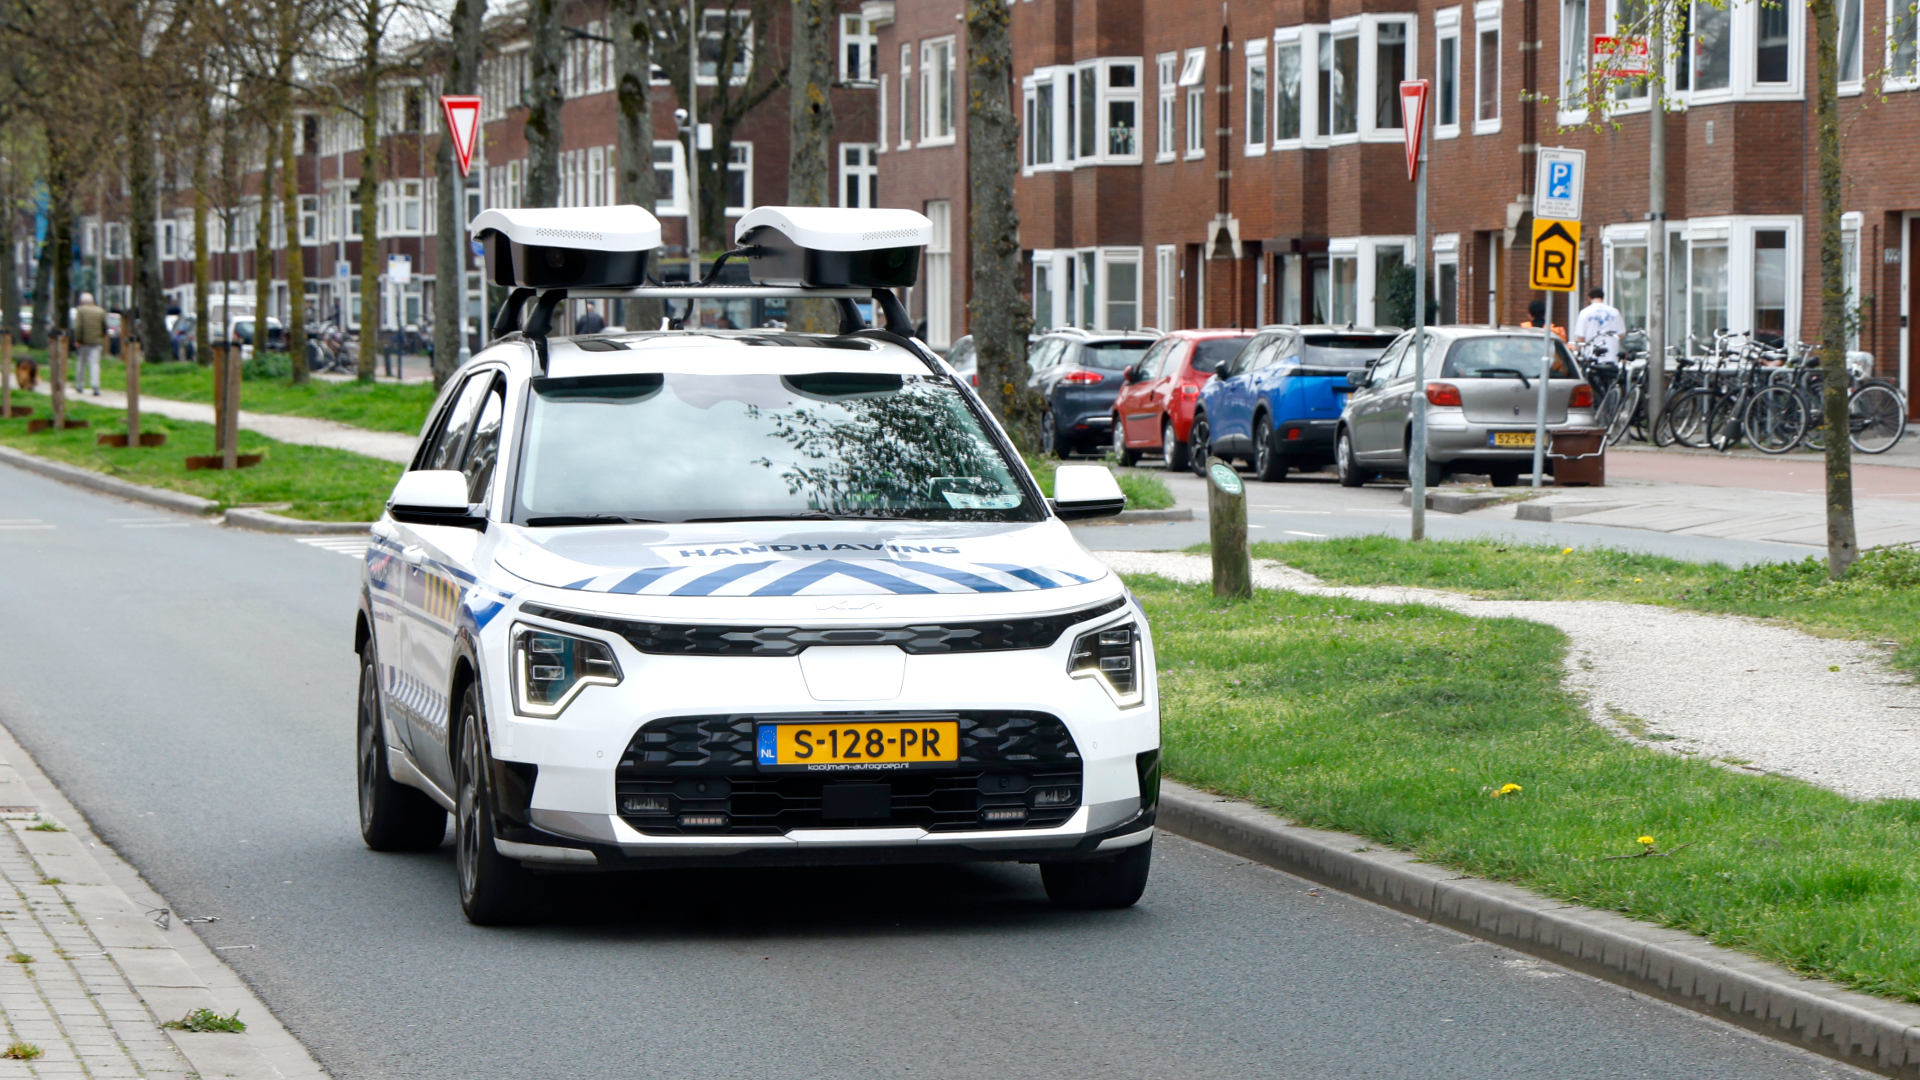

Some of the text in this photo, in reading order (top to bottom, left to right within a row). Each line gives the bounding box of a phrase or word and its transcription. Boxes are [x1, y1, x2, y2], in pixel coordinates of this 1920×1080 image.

[1553, 164, 1568, 184] P
[1543, 250, 1566, 278] R
[679, 542, 961, 558] HANDHAVING
[794, 727, 941, 760] S-128-PR
[761, 748, 775, 759] NL
[807, 761, 909, 771] kooijman-autogroep.nl
